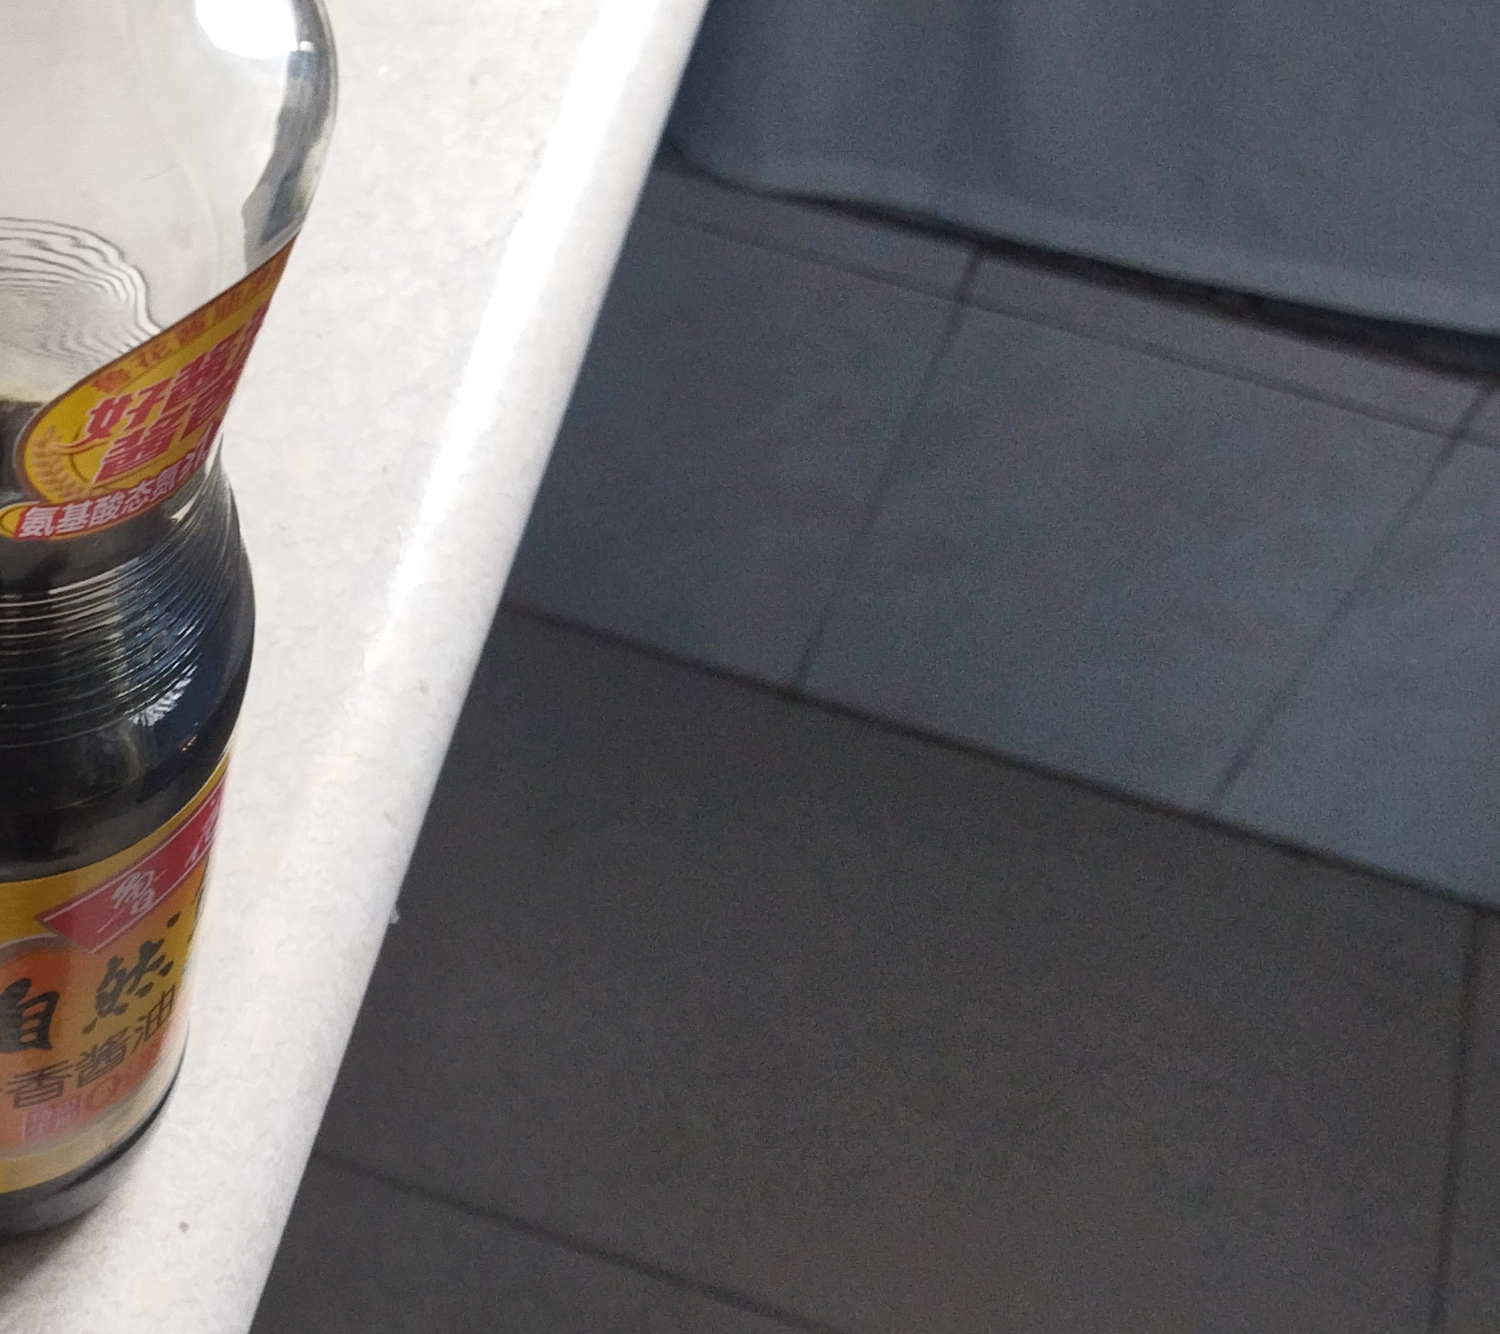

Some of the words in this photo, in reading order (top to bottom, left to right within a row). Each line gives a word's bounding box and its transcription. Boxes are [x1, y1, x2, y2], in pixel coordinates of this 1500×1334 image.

[18, 422, 214, 539] 氨基酸态氮
